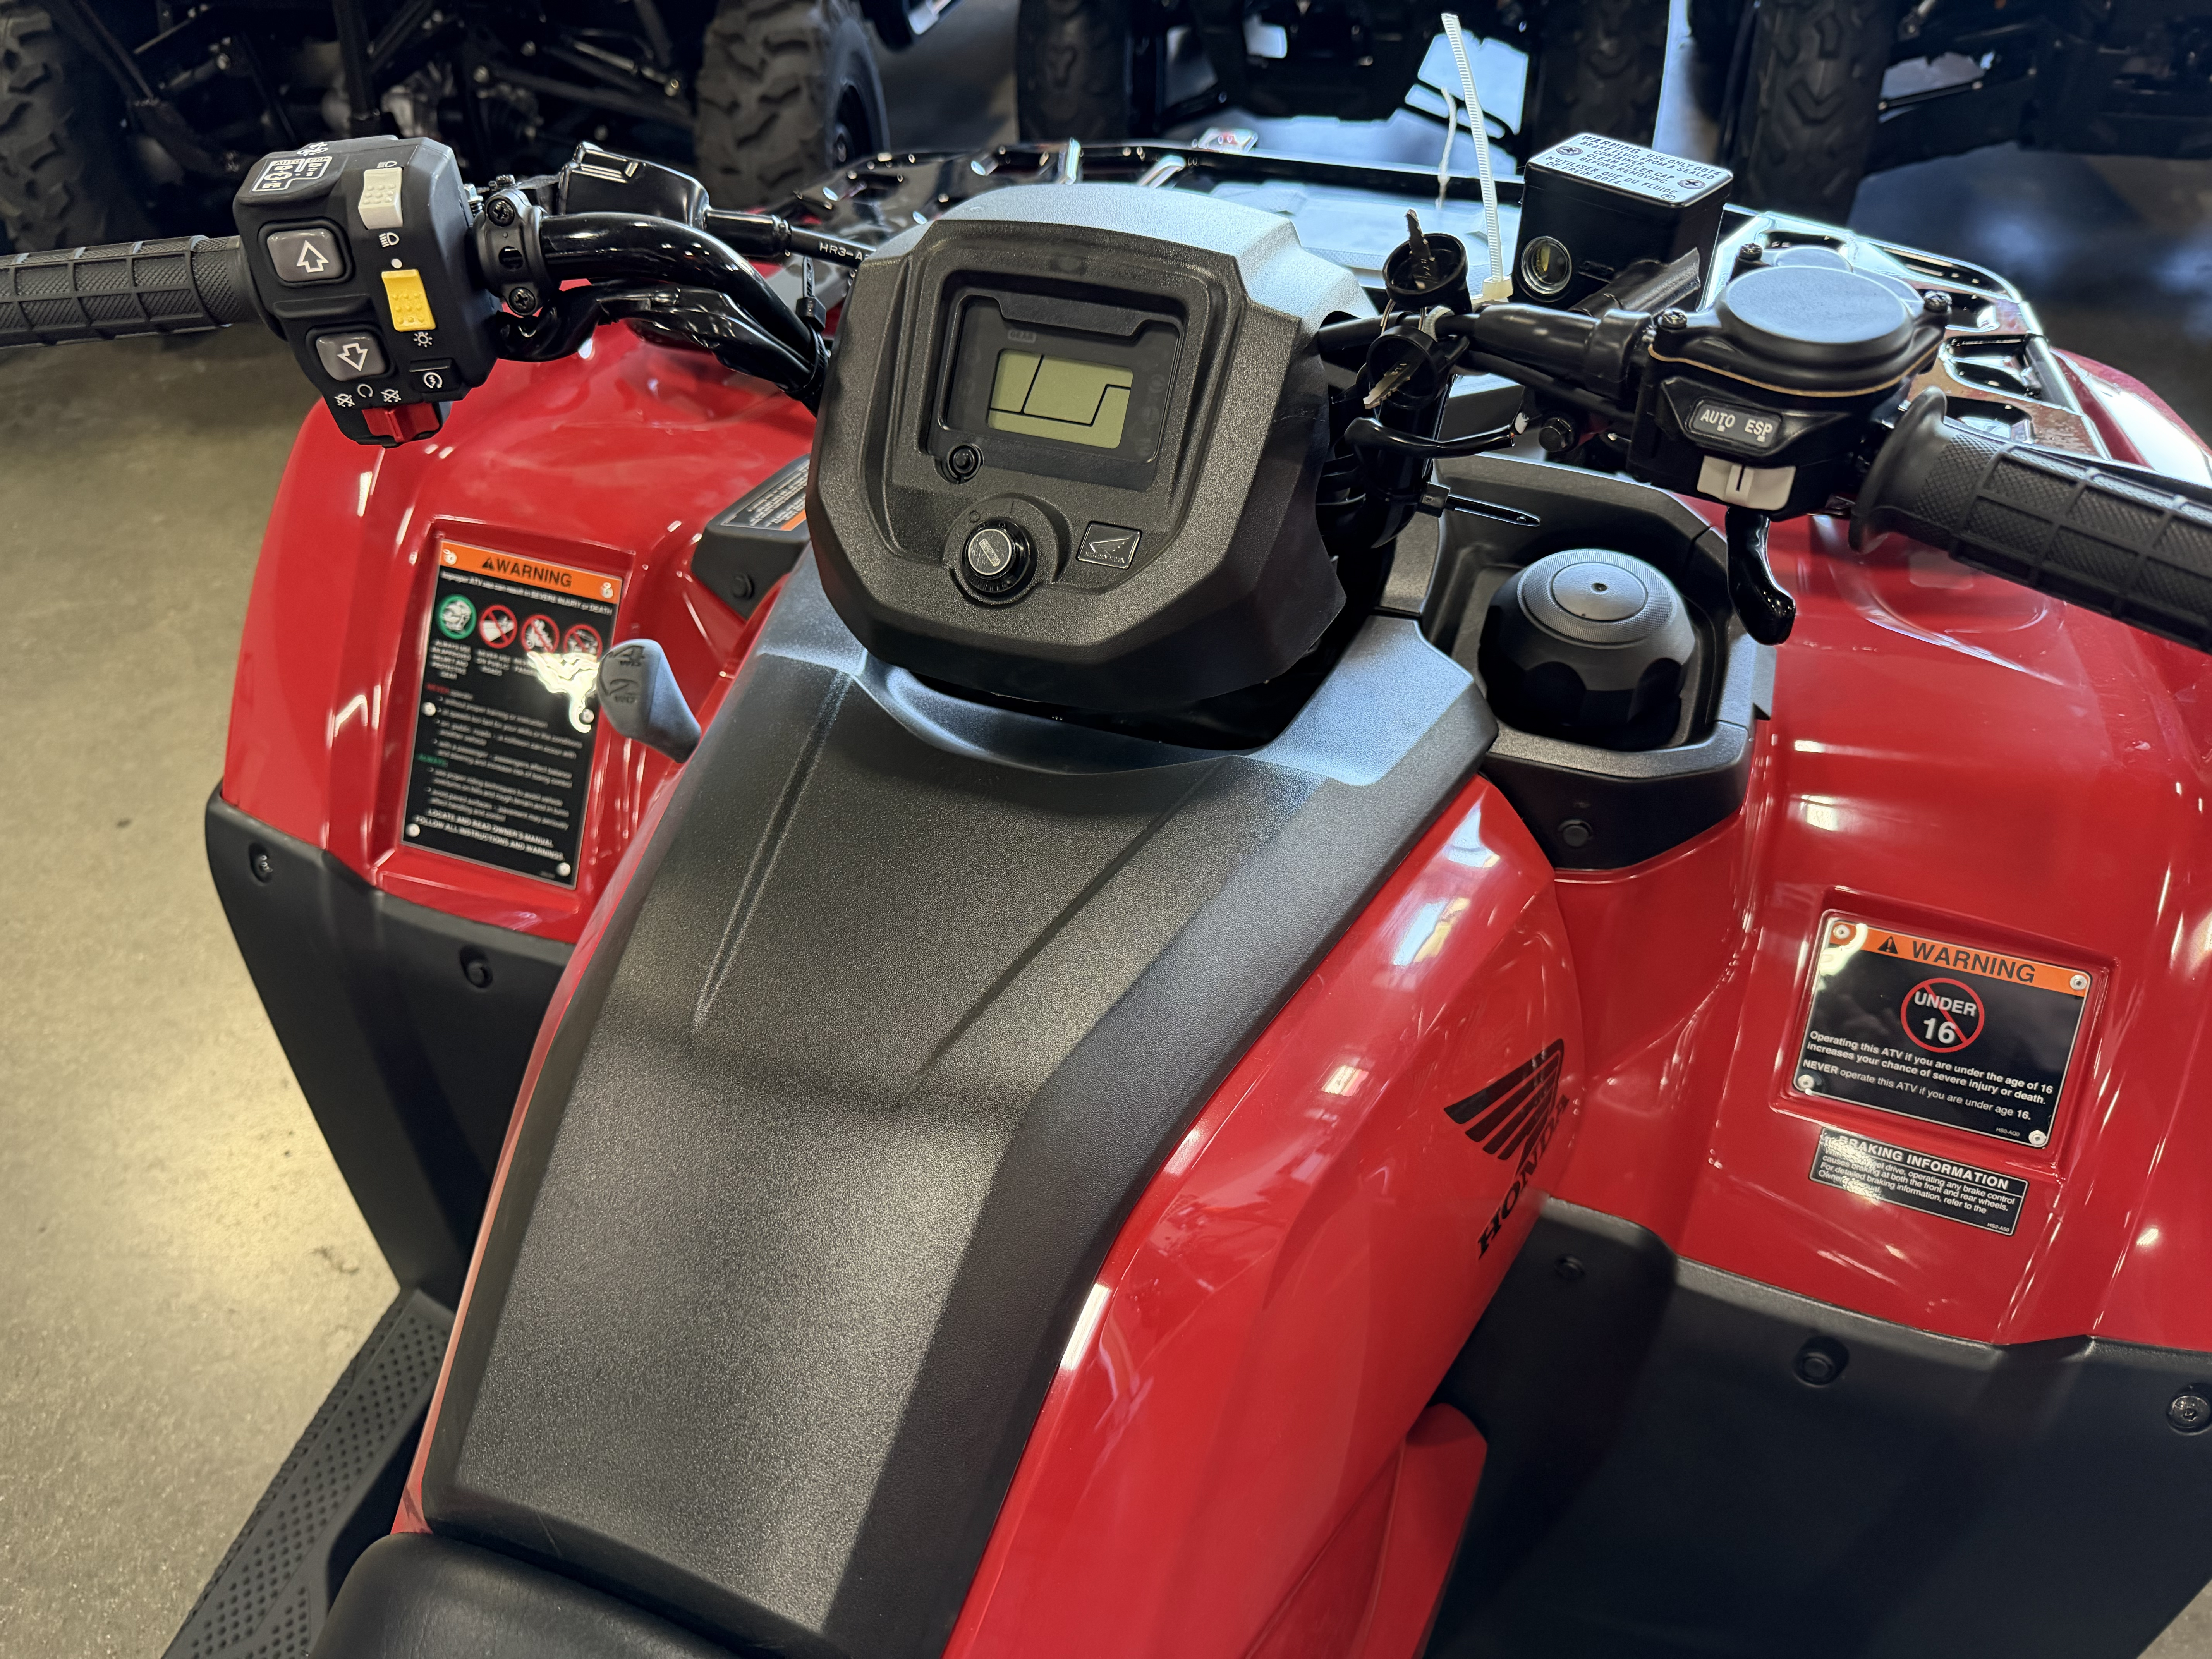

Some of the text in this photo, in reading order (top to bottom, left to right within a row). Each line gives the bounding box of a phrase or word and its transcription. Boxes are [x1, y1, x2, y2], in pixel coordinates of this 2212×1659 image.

[1561, 166, 1592, 176] FREIN
[1579, 157, 1668, 184] BEFORE REMOVING.
[1580, 141, 1613, 151] BRAKE
[1612, 150, 1639, 159] FLUID
[1640, 157, 1667, 167] FROM
[1676, 167, 1715, 180] SEALED
[1582, 136, 1723, 175] WARNING USE ONLY DOT4
[1587, 154, 1619, 164] CLEAN
[1618, 163, 1654, 173] FILLER
[1593, 150, 1644, 167] CONTAINER.
[1546, 156, 1599, 172] N'UTILISER
[1601, 171, 1623, 179] QUE
[1641, 182, 1678, 194] FLUIDE
[819, 242, 870, 261] HR3-A
[1700, 409, 1773, 436] AUTO ESP
[495, 558, 572, 588] WARNING
[610, 678, 638, 695] 2
[1912, 940, 2037, 984] WARNING
[1913, 991, 1978, 1018] UNDER
[1922, 1018, 1957, 1044] 16
[1807, 1042, 2046, 1104] increases your chance of severe injury or death.
[1810, 1030, 2054, 1094] Operating this ATV if you are under the age of 16
[1803, 1059, 2031, 1120] NEVER operate this ATV if you are under age 16.
[1477, 1094, 1570, 1261] HONDA
[1839, 1135, 1904, 1161] BRAKING
[1907, 1154, 2009, 1190] INFORMATION
[1820, 1162, 1834, 1172] For
[1835, 1166, 1866, 1180] detailed
[1867, 1175, 1896, 1190] braking
[1897, 1183, 1942, 1202] information,
[1943, 1197, 1963, 1207] refer
[1964, 1201, 1973, 1210] to
[1973, 1205, 1987, 1214] the
[1822, 1155, 1851, 1168] causes
[1851, 1162, 1881, 1177] braking
[1891, 1172, 1908, 1183] both
[1909, 1178, 1923, 1187] the
[1923, 1182, 1942, 1194] front
[1943, 1188, 1960, 1198] and
[1960, 1193, 1977, 1202] rear
[1978, 1197, 2008, 1211] wheels.
[1908, 1171, 1945, 1187] operating
[1946, 1181, 1961, 1191] any
[1963, 1185, 1986, 1197] brake
[1987, 1193, 2016, 1205] control
